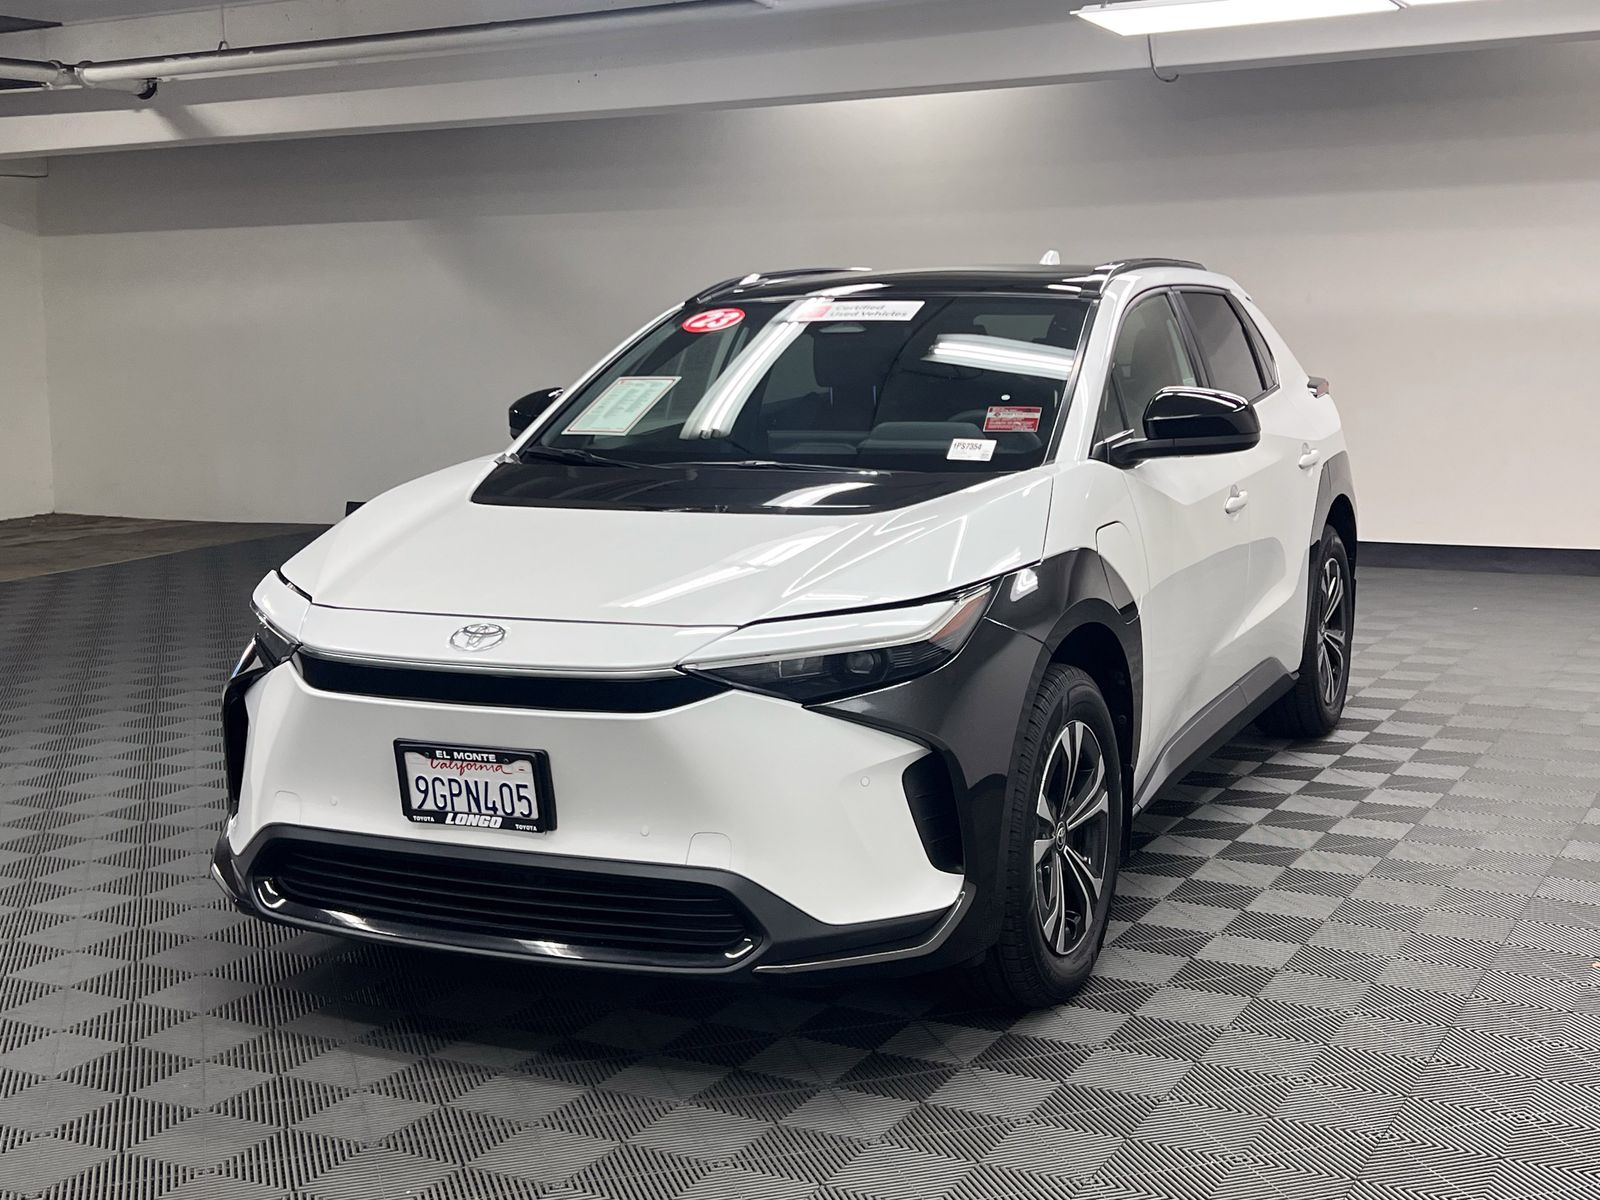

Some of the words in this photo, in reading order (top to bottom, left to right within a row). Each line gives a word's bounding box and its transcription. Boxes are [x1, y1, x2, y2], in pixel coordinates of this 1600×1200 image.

[435, 750, 451, 759] EL
[453, 751, 497, 762] MONTE
[415, 775, 533, 818] 9GPN405
[445, 812, 503, 829] LONGO
[514, 823, 538, 831] TOYOTA
